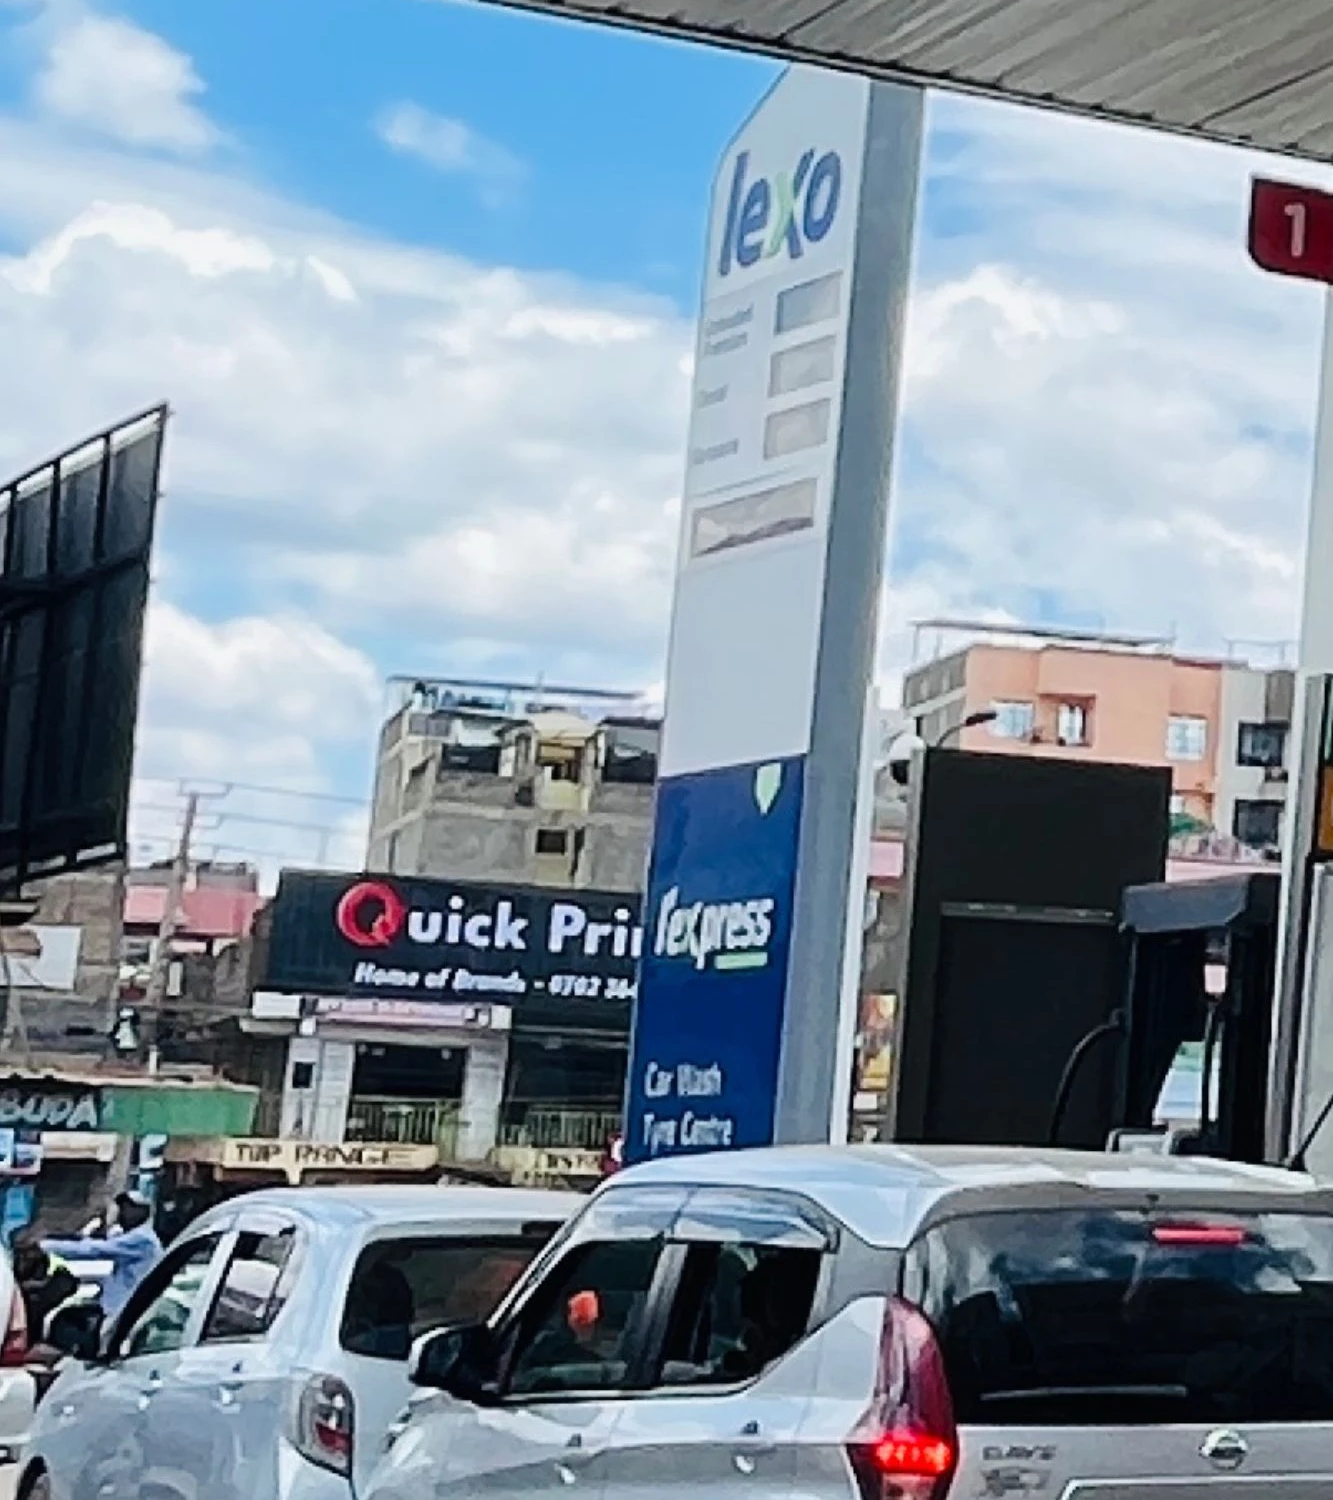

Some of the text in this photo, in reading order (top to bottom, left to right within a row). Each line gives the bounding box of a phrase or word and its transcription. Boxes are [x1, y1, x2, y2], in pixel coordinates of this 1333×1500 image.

[717, 147, 842, 276] lexo
[1284, 202, 1306, 257] 1
[337, 881, 529, 949] Quick
[644, 1061, 675, 1098] Car
